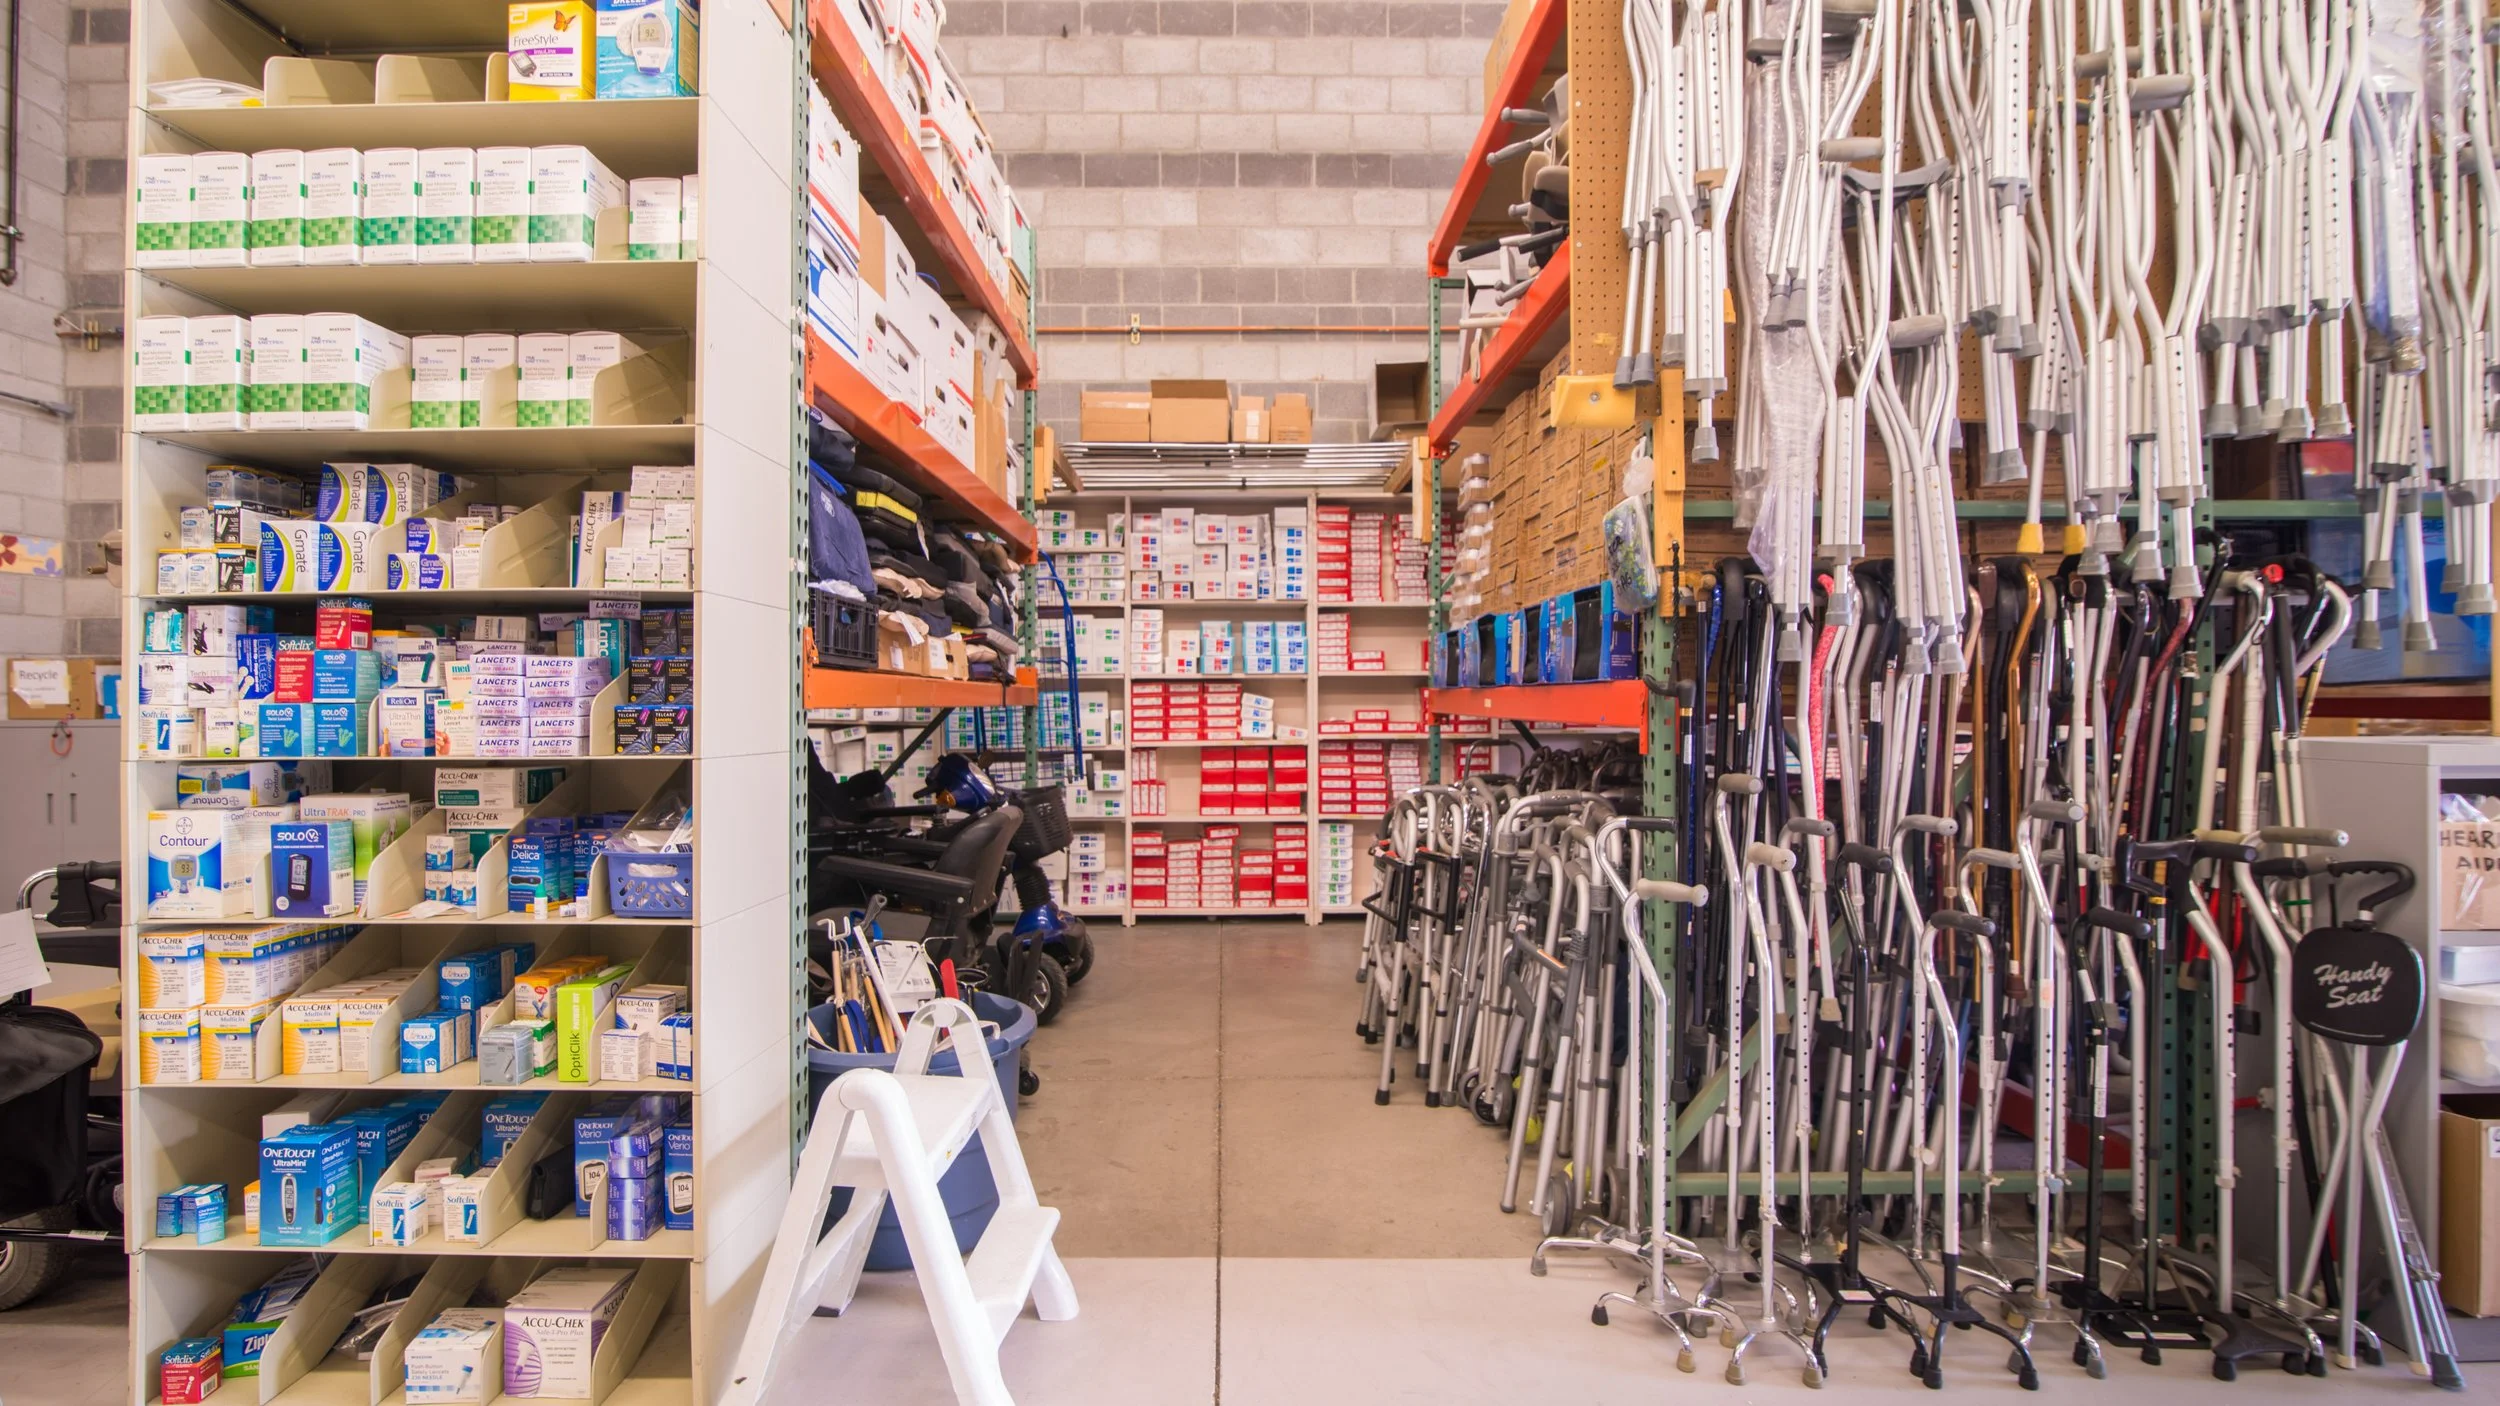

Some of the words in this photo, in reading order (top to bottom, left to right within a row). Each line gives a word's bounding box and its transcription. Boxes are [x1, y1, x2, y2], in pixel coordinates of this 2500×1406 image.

[513, 34, 559, 46] FreeStyle
[351, 470, 365, 511] Gmate
[397, 472, 410, 513] Gmate
[584, 501, 597, 555] ACCU-CHEK
[295, 529, 308, 572] Gmate
[353, 530, 366, 573] Gmate
[279, 640, 311, 652] Softclix
[19, 670, 58, 681] Recycle
[390, 697, 416, 706] ReliOn
[141, 710, 169, 719] Softclix
[439, 772, 478, 780] ACCU-CHEK
[192, 797, 228, 805] Contour
[449, 812, 499, 820] ACCU-CHEK
[159, 835, 208, 846] Contour
[277, 832, 304, 841] SOLO
[2439, 829, 2500, 849] HEAR
[511, 850, 540, 860] Delica
[2456, 856, 2500, 871] AID
[142, 937, 183, 945] ACCU-CHEK
[208, 933, 249, 941] ACCU-CHEK
[2313, 960, 2394, 987] Handy
[2326, 985, 2383, 1009] Seat
[287, 1003, 331, 1012] ACCU-CHEK
[343, 1003, 384, 1011] ACCU-CHEK
[618, 999, 654, 1007] ACCU-CHEK
[140, 1012, 182, 1021] ACCU-CHEK
[205, 1009, 245, 1017] ACCU-CHEK
[570, 1032, 582, 1078] OptiClik
[485, 1114, 534, 1124] ONETOUCH
[578, 1122, 613, 1130] ONETOUCH
[578, 1130, 602, 1139] Verio
[322, 1138, 350, 1155] ONETOUCH
[668, 1141, 690, 1150] Verio
[263, 1147, 315, 1158] ONETOUCH
[678, 1184, 689, 1192] 104
[376, 1199, 404, 1208] Softclix
[447, 1196, 475, 1204] Softclix
[521, 1317, 584, 1328] ACCU-CHEK
[165, 1355, 195, 1364] Softclix
